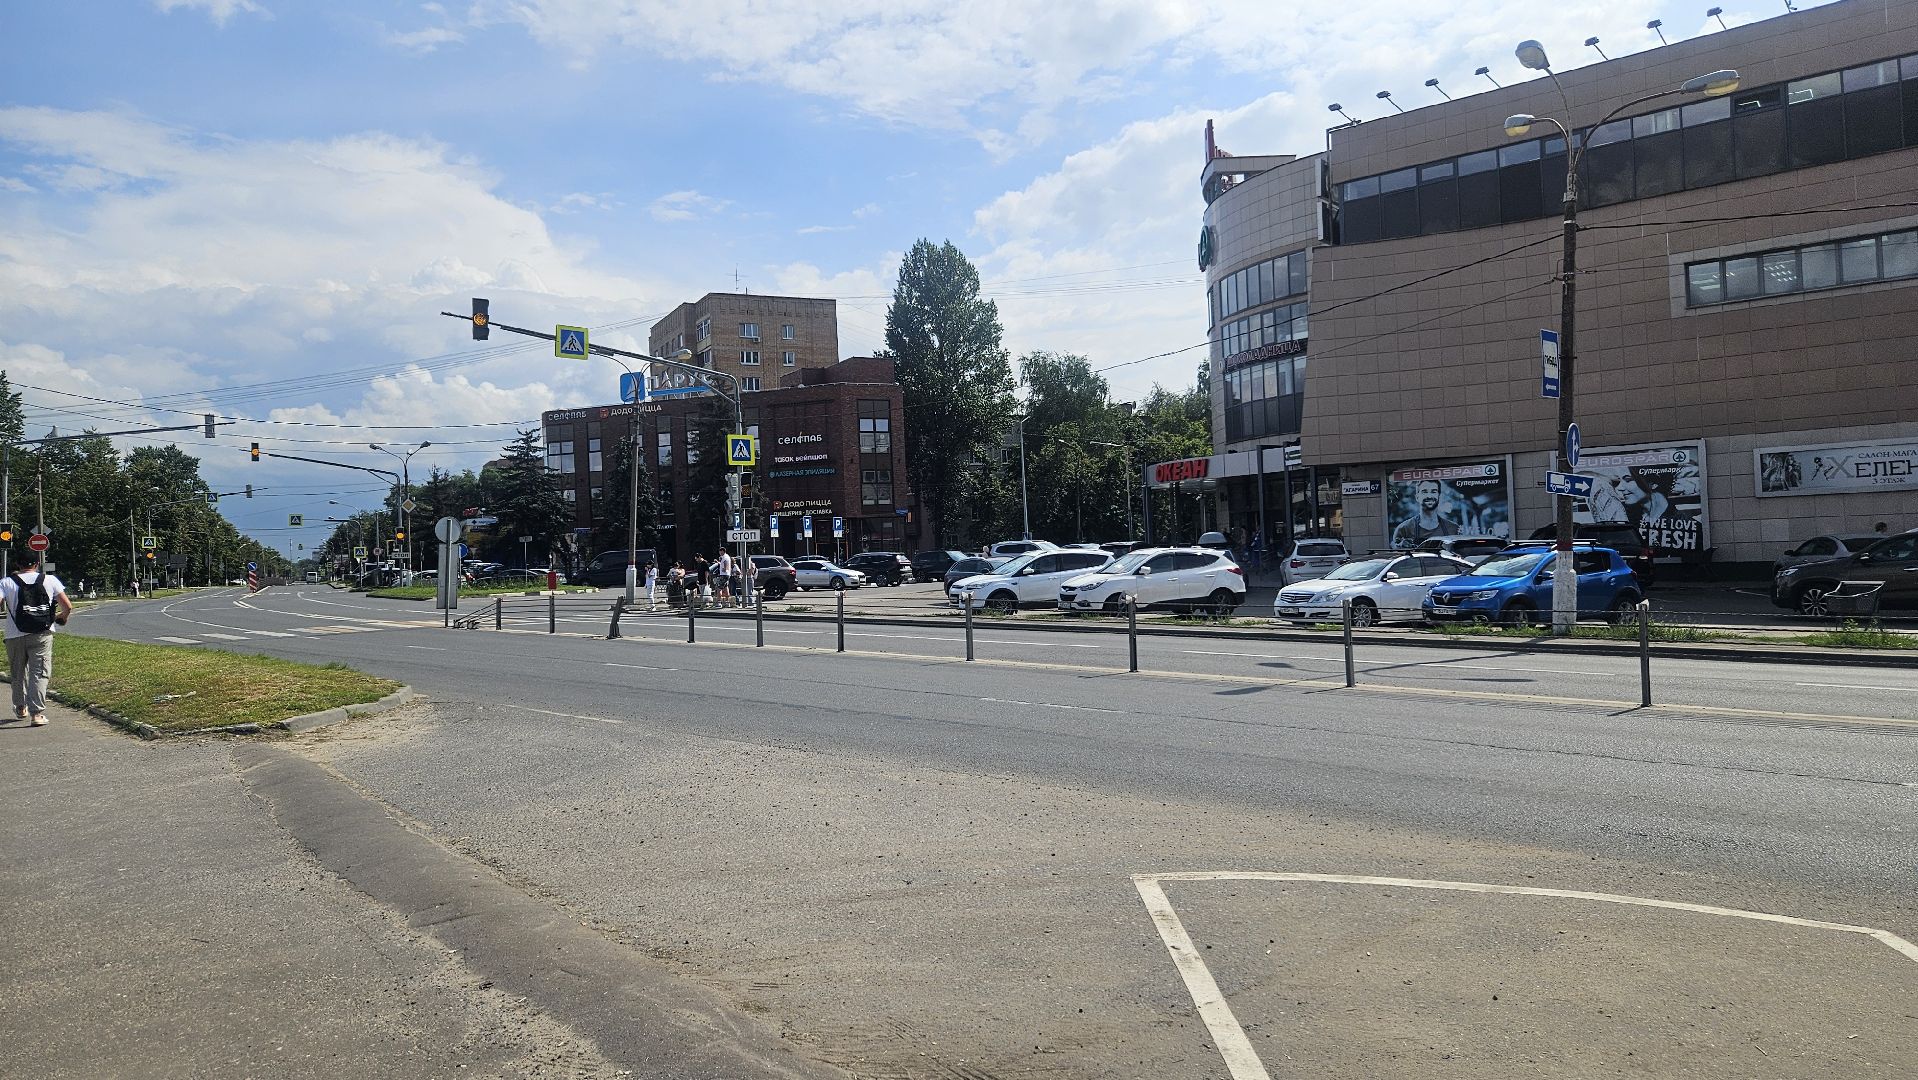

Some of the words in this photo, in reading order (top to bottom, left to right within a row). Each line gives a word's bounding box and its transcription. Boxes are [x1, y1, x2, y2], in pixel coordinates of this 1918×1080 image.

[647, 370, 714, 389] ПАРУС
[610, 407, 633, 416] ДОДО
[1579, 454, 1670, 467] EUROSPAR
[1155, 459, 1210, 482] ОКЕАН
[1402, 467, 1482, 480] EUROSPAR
[1639, 466, 1684, 476] Супермарк
[1370, 483, 1380, 491] 67
[783, 500, 805, 509] ДОДО
[805, 499, 832, 507] ПИЦЦА
[1670, 518, 1698, 531] LOVE
[731, 532, 757, 541] СТОП
[1639, 528, 1697, 550] FRESH
